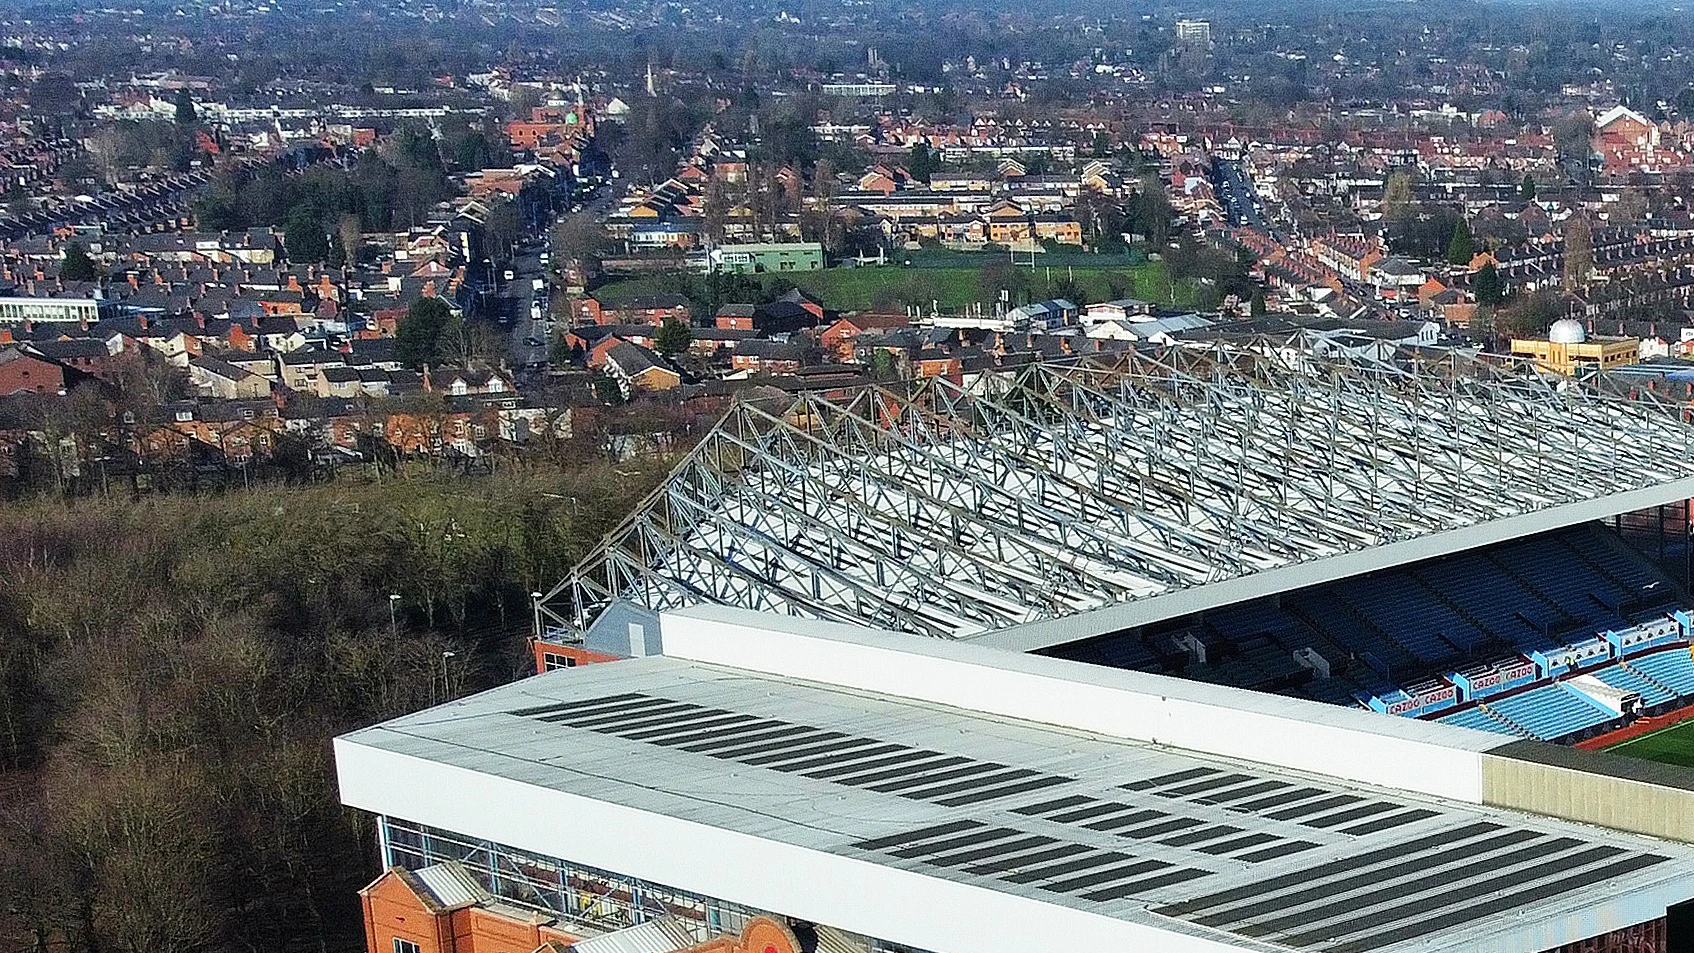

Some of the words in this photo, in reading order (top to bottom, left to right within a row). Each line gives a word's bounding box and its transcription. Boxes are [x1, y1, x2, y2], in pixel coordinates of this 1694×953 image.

[1473, 676, 1500, 690] CAZOO
[1506, 666, 1532, 680] CAZOO
[1389, 700, 1419, 714] CAZOO
[1425, 690, 1453, 704] CAZOO
